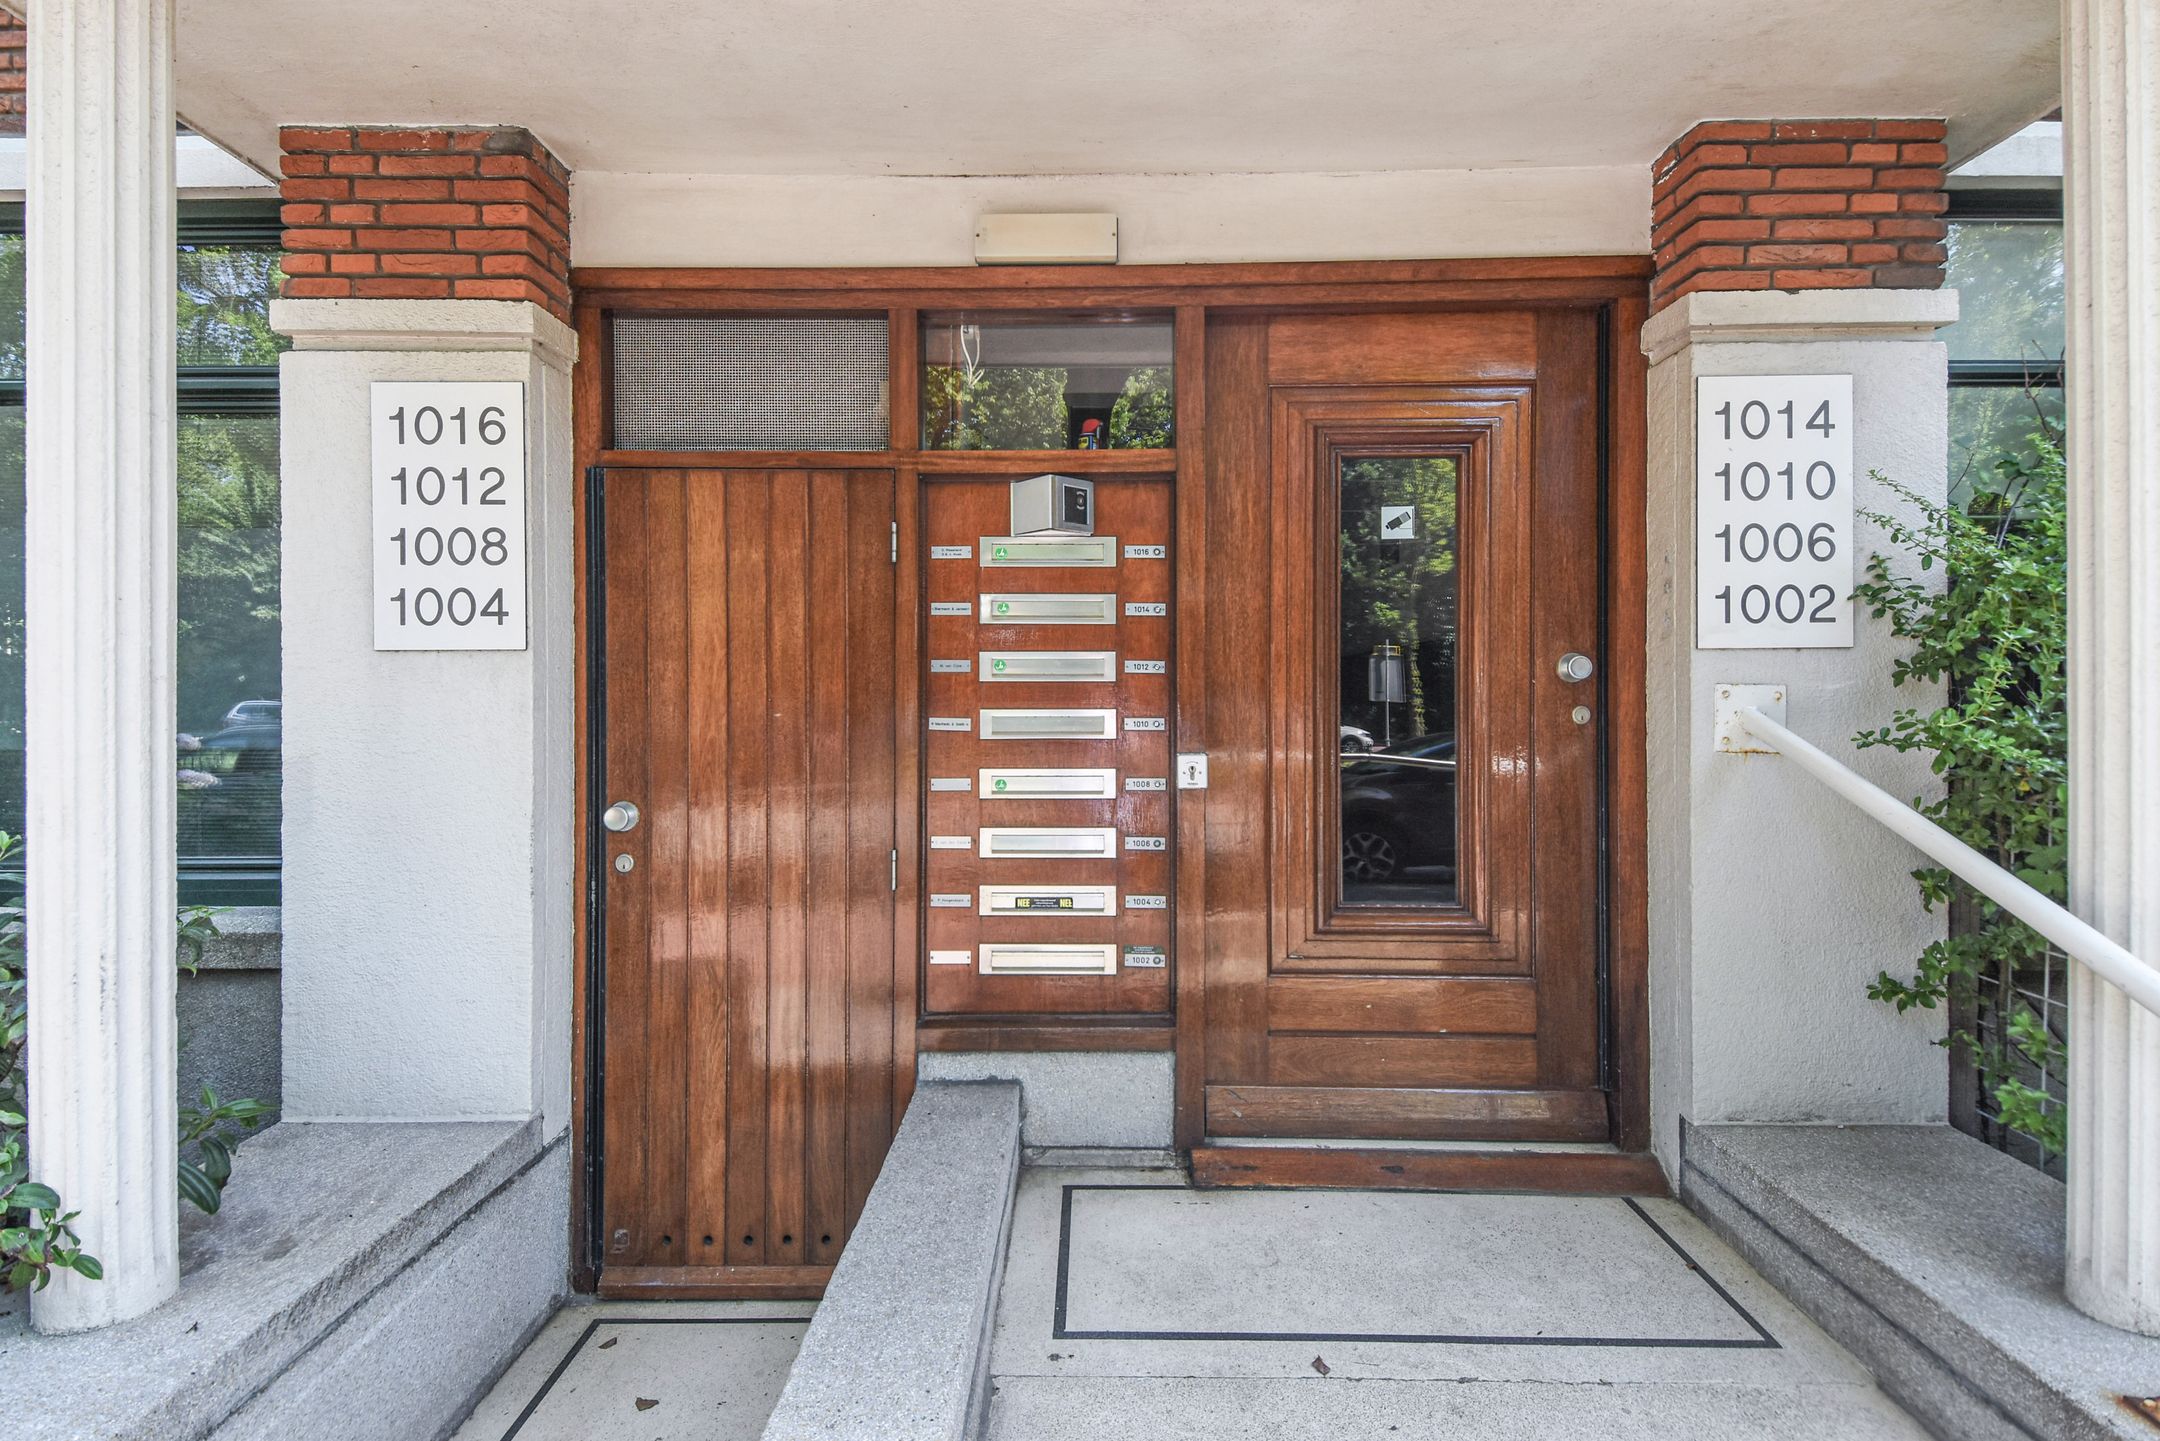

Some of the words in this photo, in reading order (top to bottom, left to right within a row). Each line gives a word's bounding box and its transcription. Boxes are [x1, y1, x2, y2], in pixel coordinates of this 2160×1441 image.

[389, 406, 507, 446] 1016
[1715, 400, 1836, 440] 1014
[390, 467, 506, 506] 1012
[1715, 461, 1836, 502] 1010
[390, 527, 508, 567] 1008
[1715, 523, 1836, 563] 1006
[390, 588, 510, 627] 1004
[1715, 584, 1837, 625] 1002
[1133, 663, 1149, 671] 1012
[1132, 720, 1149, 728] 1010
[1017, 898, 1031, 908] NEE
[1132, 956, 1151, 964] 1002
